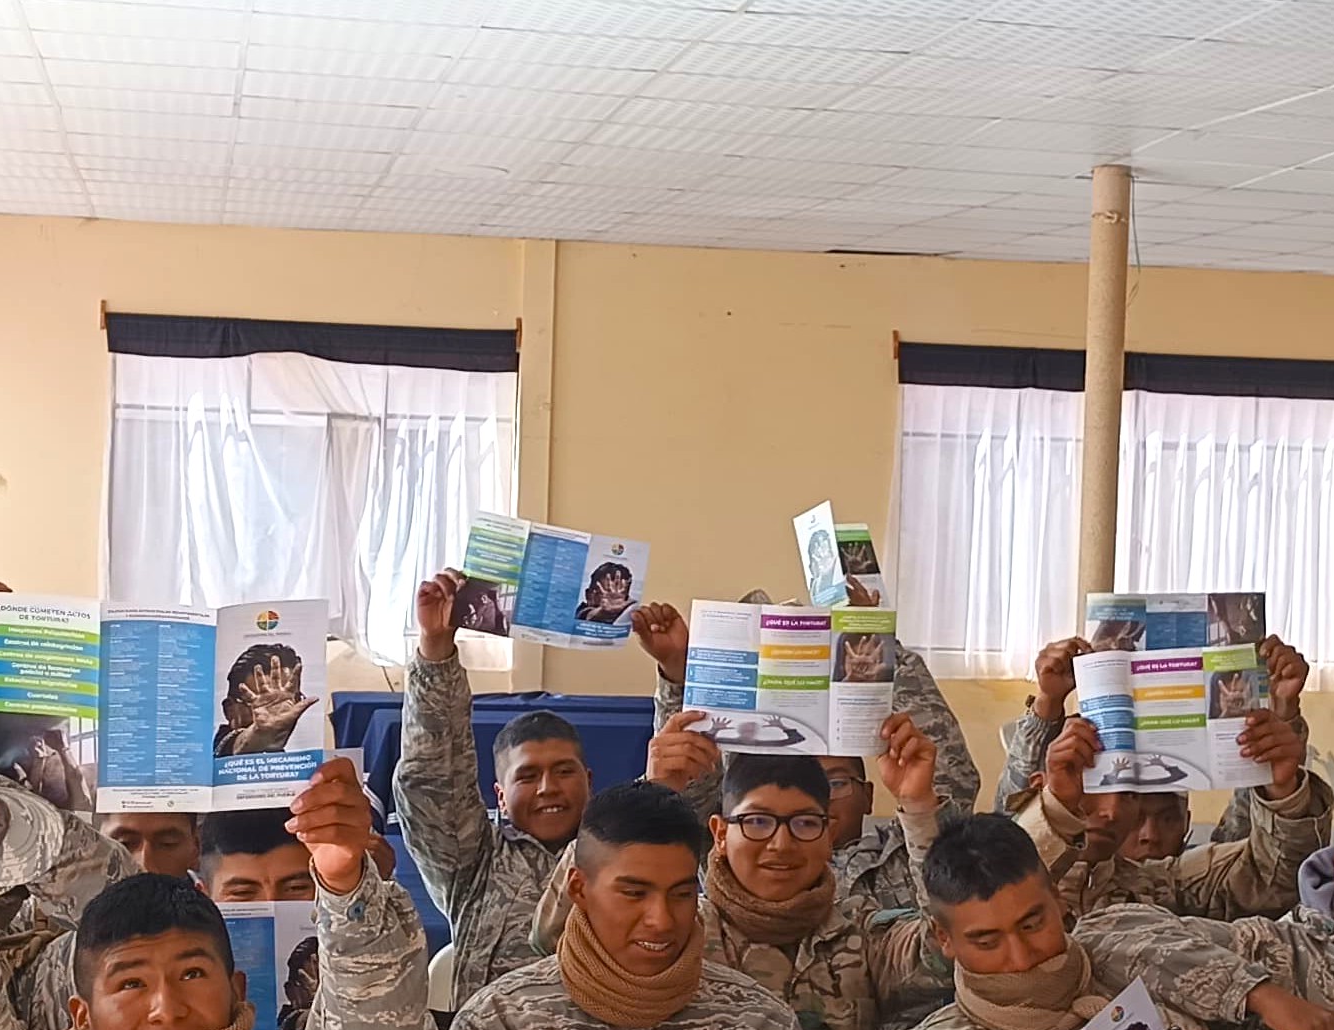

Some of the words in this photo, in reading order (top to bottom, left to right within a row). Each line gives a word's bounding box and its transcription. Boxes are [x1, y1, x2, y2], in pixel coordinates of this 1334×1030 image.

[224, 758, 244, 769] ¿QUÉ
[245, 758, 255, 766] ES
[267, 754, 311, 764] MECANISMO
[218, 765, 257, 775] NACIONAL
[258, 764, 269, 772] DE
[260, 771, 299, 780] TORTURA?
